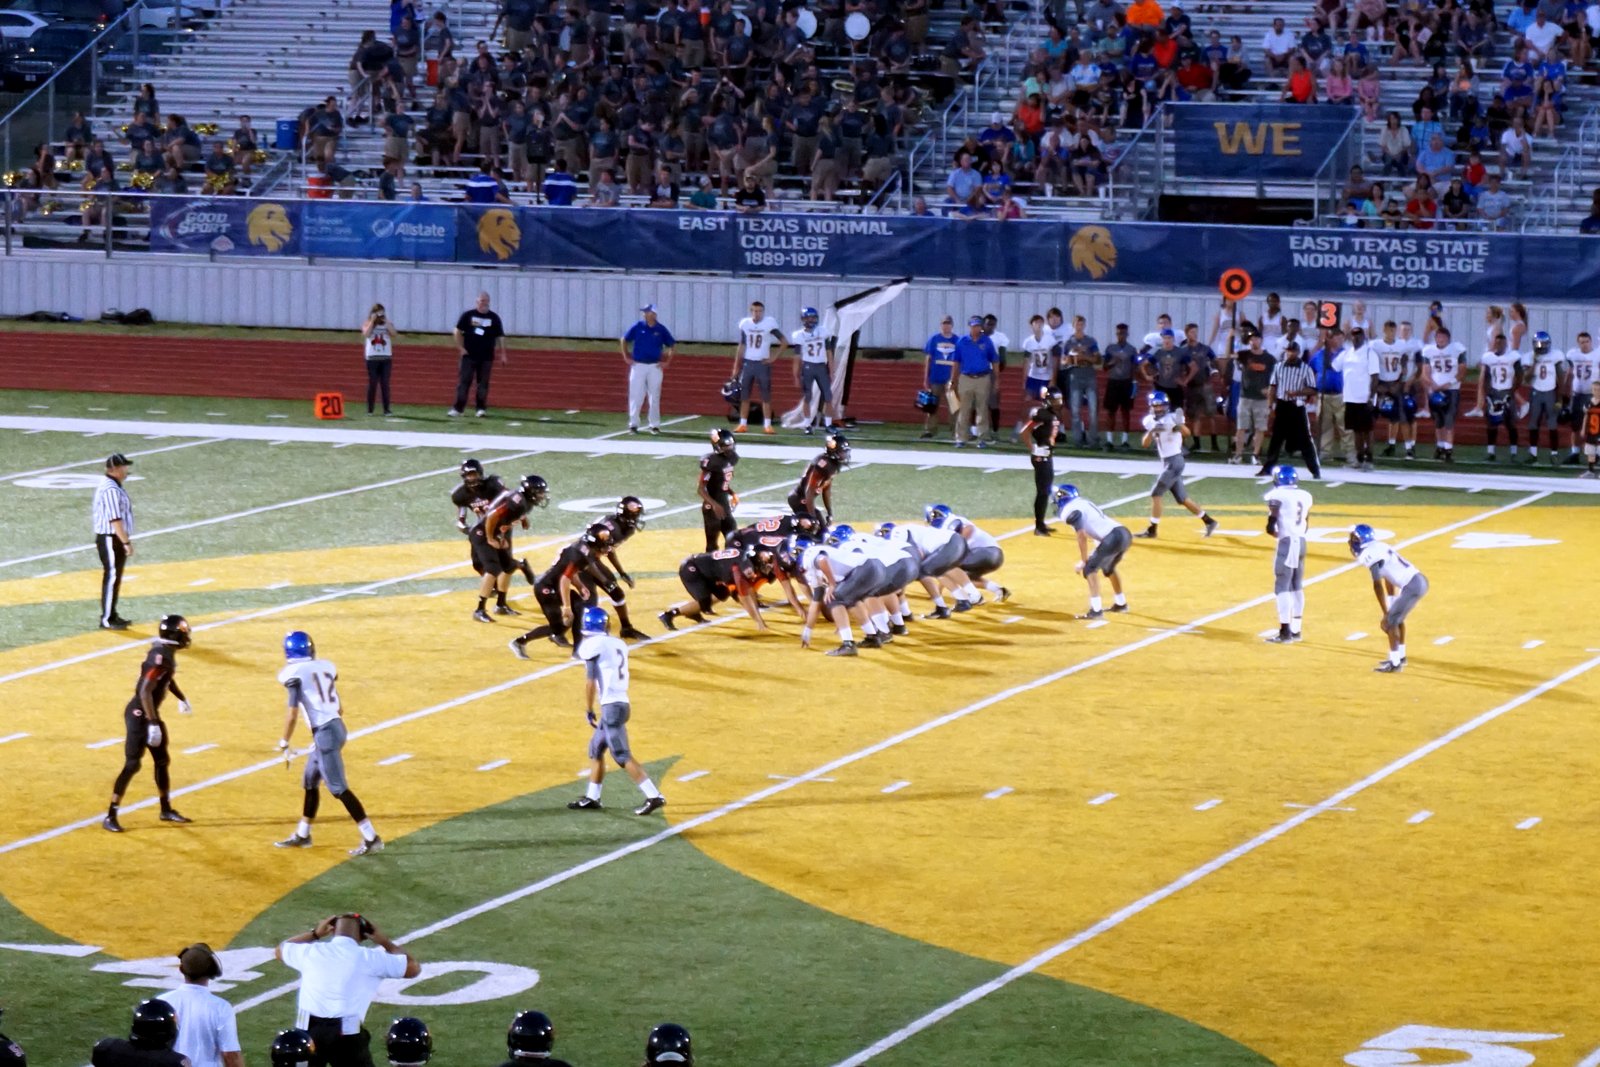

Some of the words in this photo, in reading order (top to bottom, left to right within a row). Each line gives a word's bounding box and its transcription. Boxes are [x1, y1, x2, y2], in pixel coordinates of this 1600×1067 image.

[1213, 122, 1303, 156] WE
[185, 212, 228, 223] GOOD
[678, 216, 729, 231] EAST
[736, 217, 800, 233] TEXAS
[806, 219, 893, 235] NORMAL
[177, 222, 232, 234] SPORT
[394, 222, 446, 237] Allstate
[740, 234, 829, 250] COLLEGE
[1289, 235, 1343, 250] EAST
[1351, 237, 1417, 253] TEXAS
[1426, 240, 1490, 256] STATE
[744, 251, 825, 267] 1889-1917
[1292, 252, 1383, 270] NORMAL
[1390, 256, 1485, 273] COLLEGE
[1346, 271, 1430, 289] 1917-1923
[1319, 302, 1337, 327] 3
[320, 396, 342, 416] 20
[615, 648, 625, 680] 2
[312, 672, 338, 703] 12
